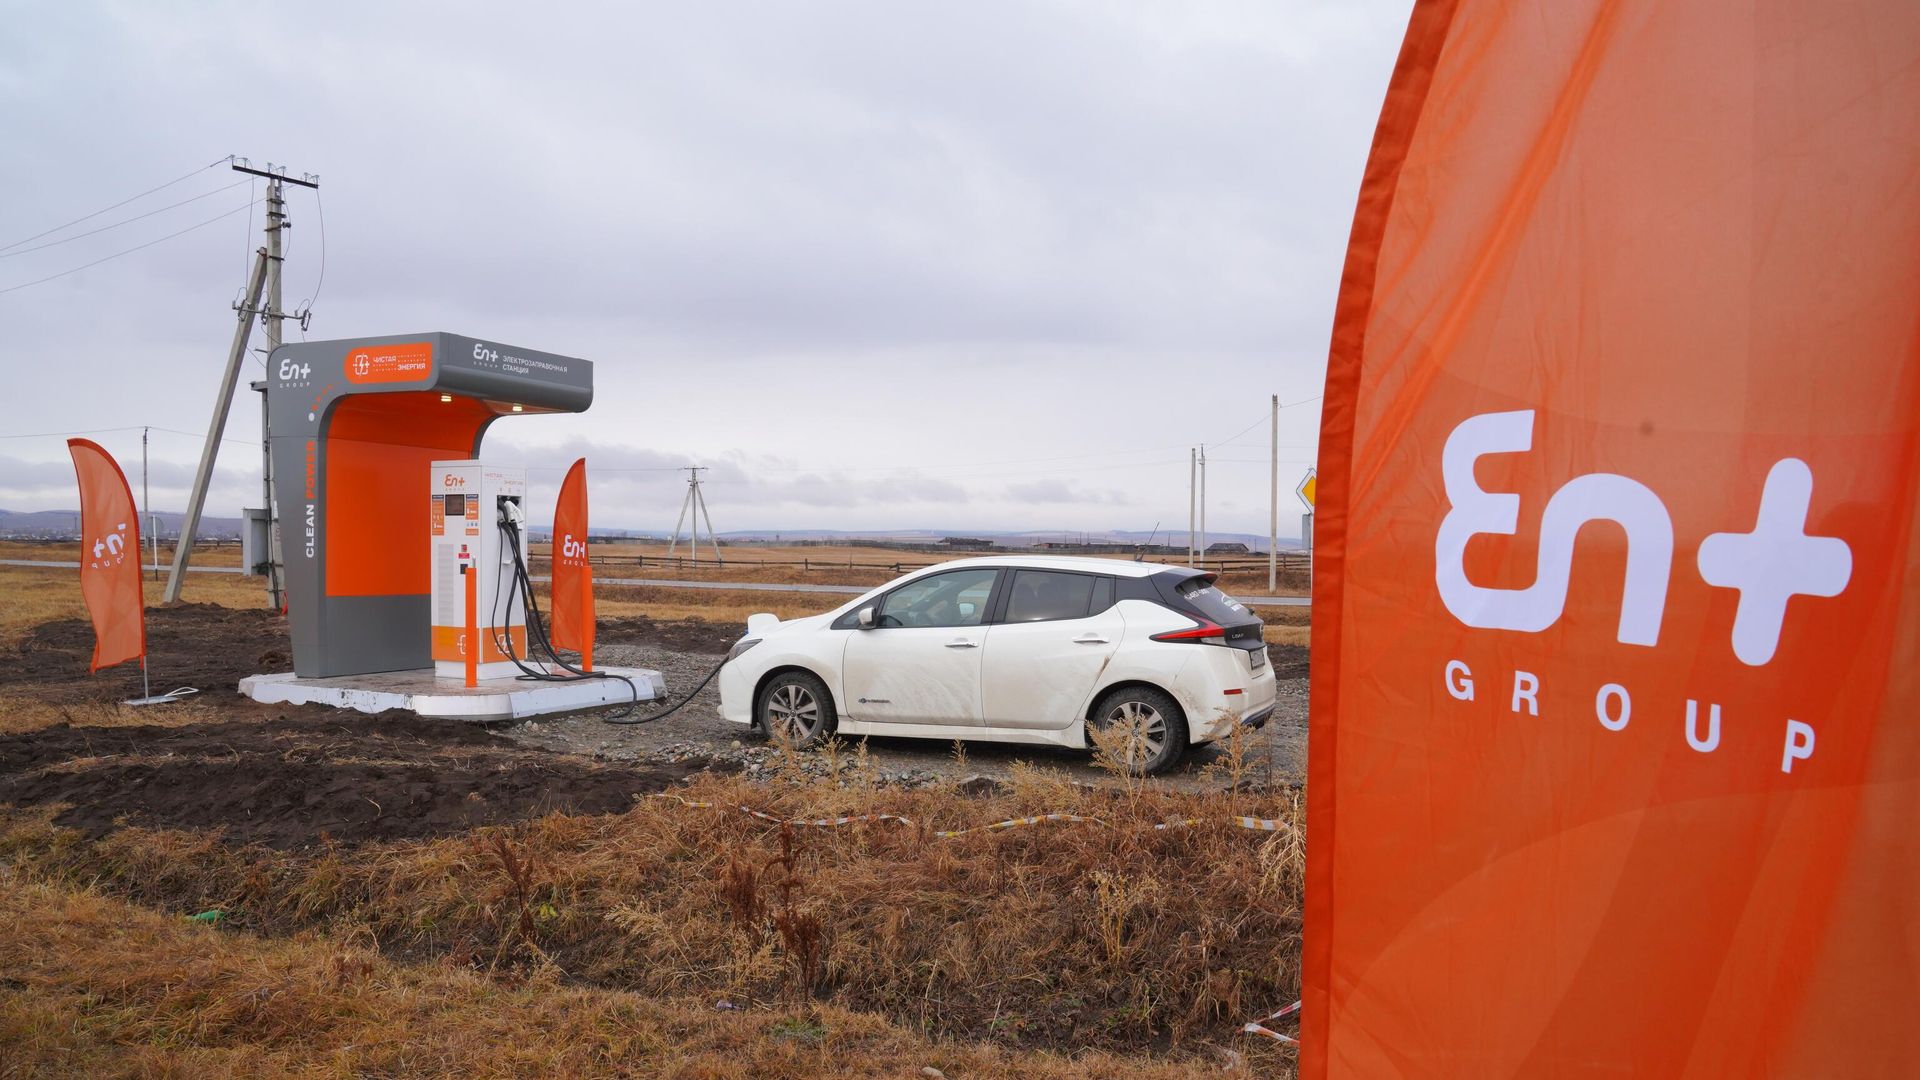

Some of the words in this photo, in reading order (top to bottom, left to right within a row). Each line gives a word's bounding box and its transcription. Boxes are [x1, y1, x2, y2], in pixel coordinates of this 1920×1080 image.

[373, 355, 397, 363] ЧИСТАЯ
[473, 343, 499, 362] En+
[279, 358, 312, 380] En+
[397, 362, 426, 371] ЭНЕРГИЯ
[502, 355, 568, 373] ЭЛЕКТРОЗАПРАВОЧНАЯ
[502, 363, 529, 375] СТАНЦИЯ
[305, 504, 315, 558] CLEAN
[1435, 409, 1853, 666] En+
[1445, 659, 1816, 773] GROUP
